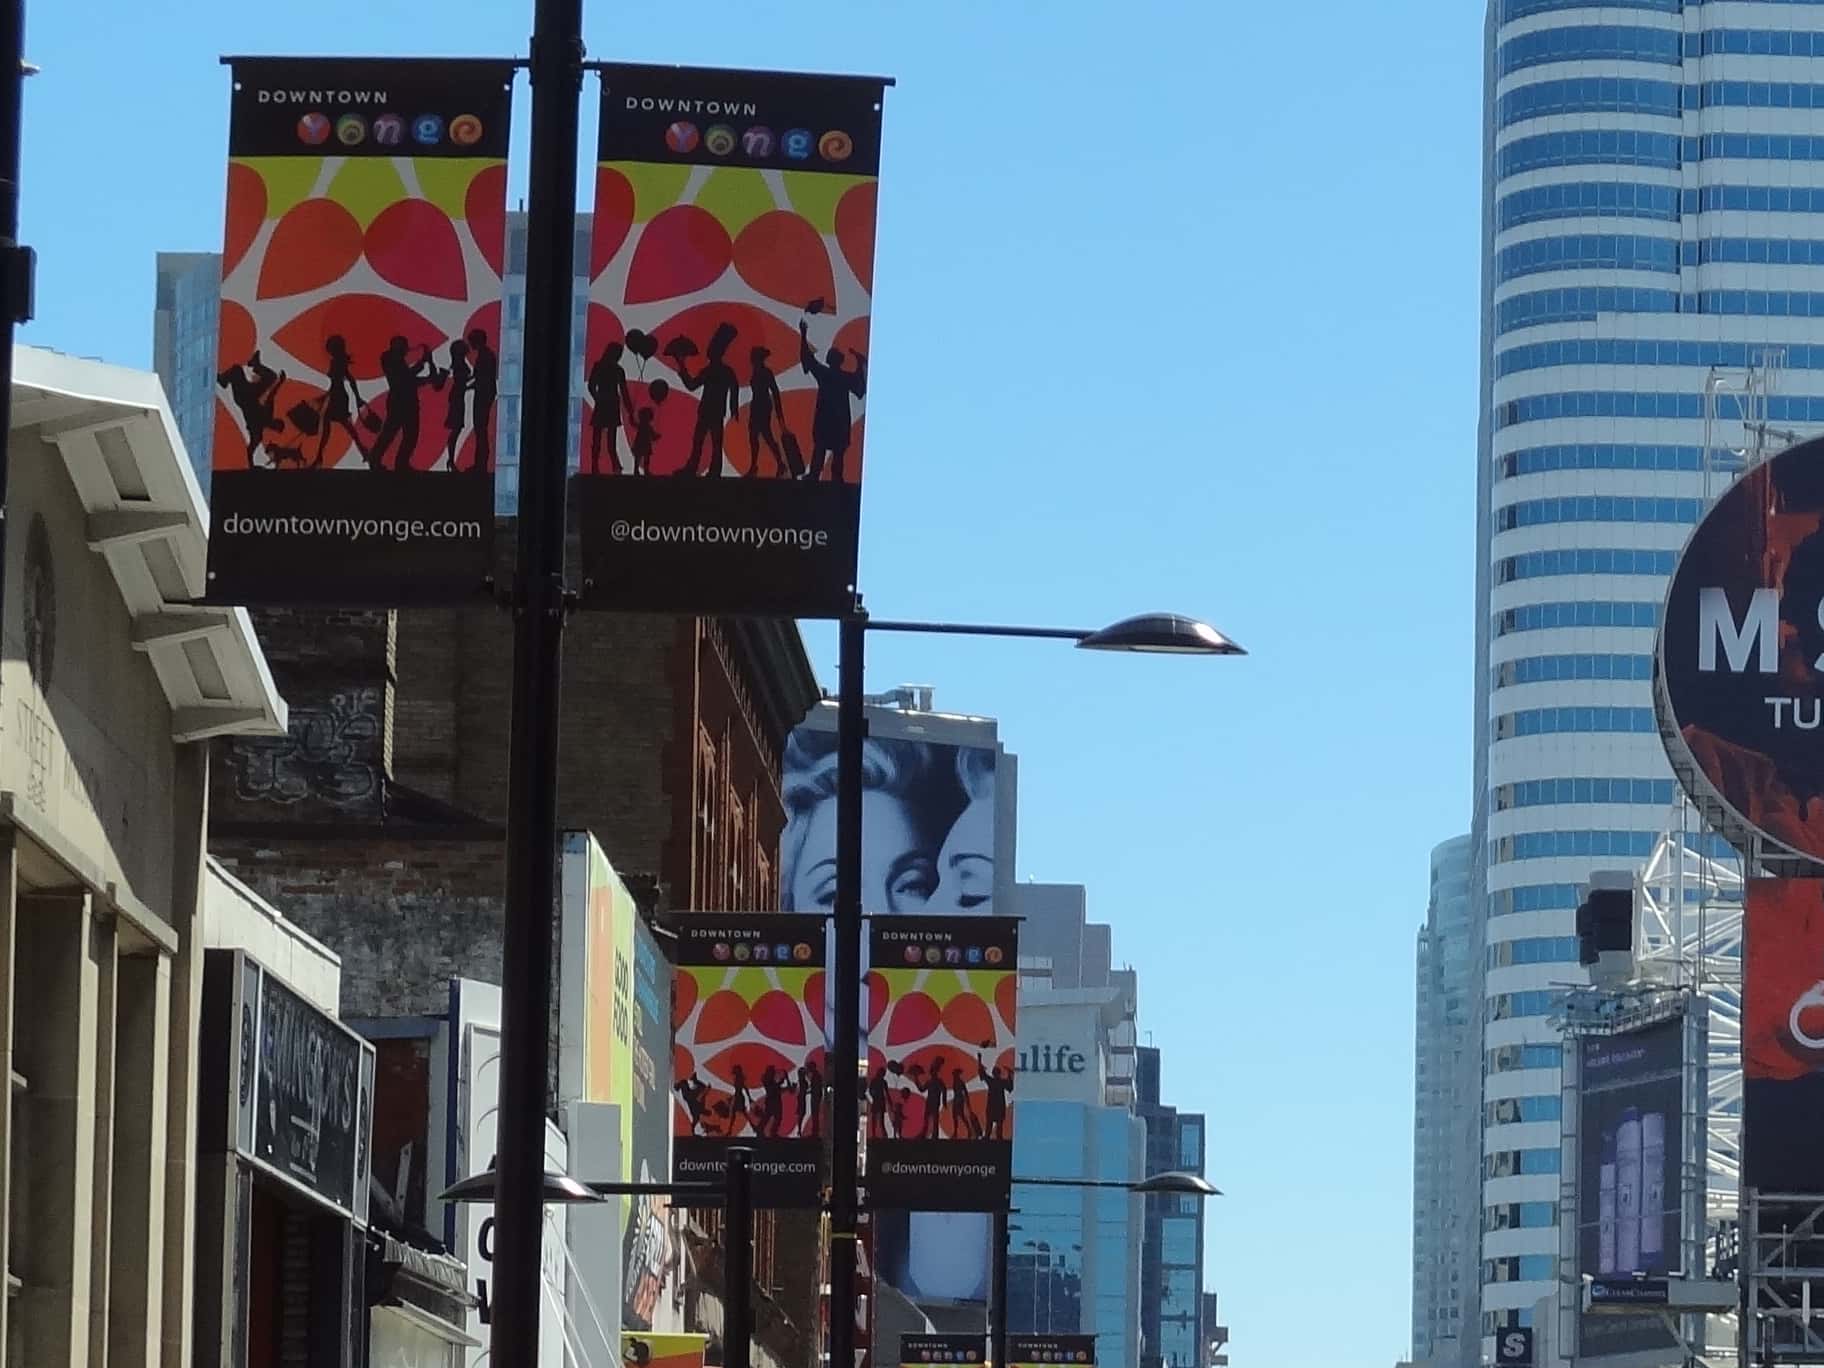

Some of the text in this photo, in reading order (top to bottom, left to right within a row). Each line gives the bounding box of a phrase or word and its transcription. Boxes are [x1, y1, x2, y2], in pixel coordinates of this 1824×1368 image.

[257, 89, 389, 105] DOWNTOWN
[626, 96, 757, 117] DOWNTOWN
[223, 512, 482, 541] downtownyonge.com
[610, 519, 829, 548] @downtownyonge
[690, 929, 761, 939] DOWNTOWN
[881, 931, 951, 941] DOWNTOWN
